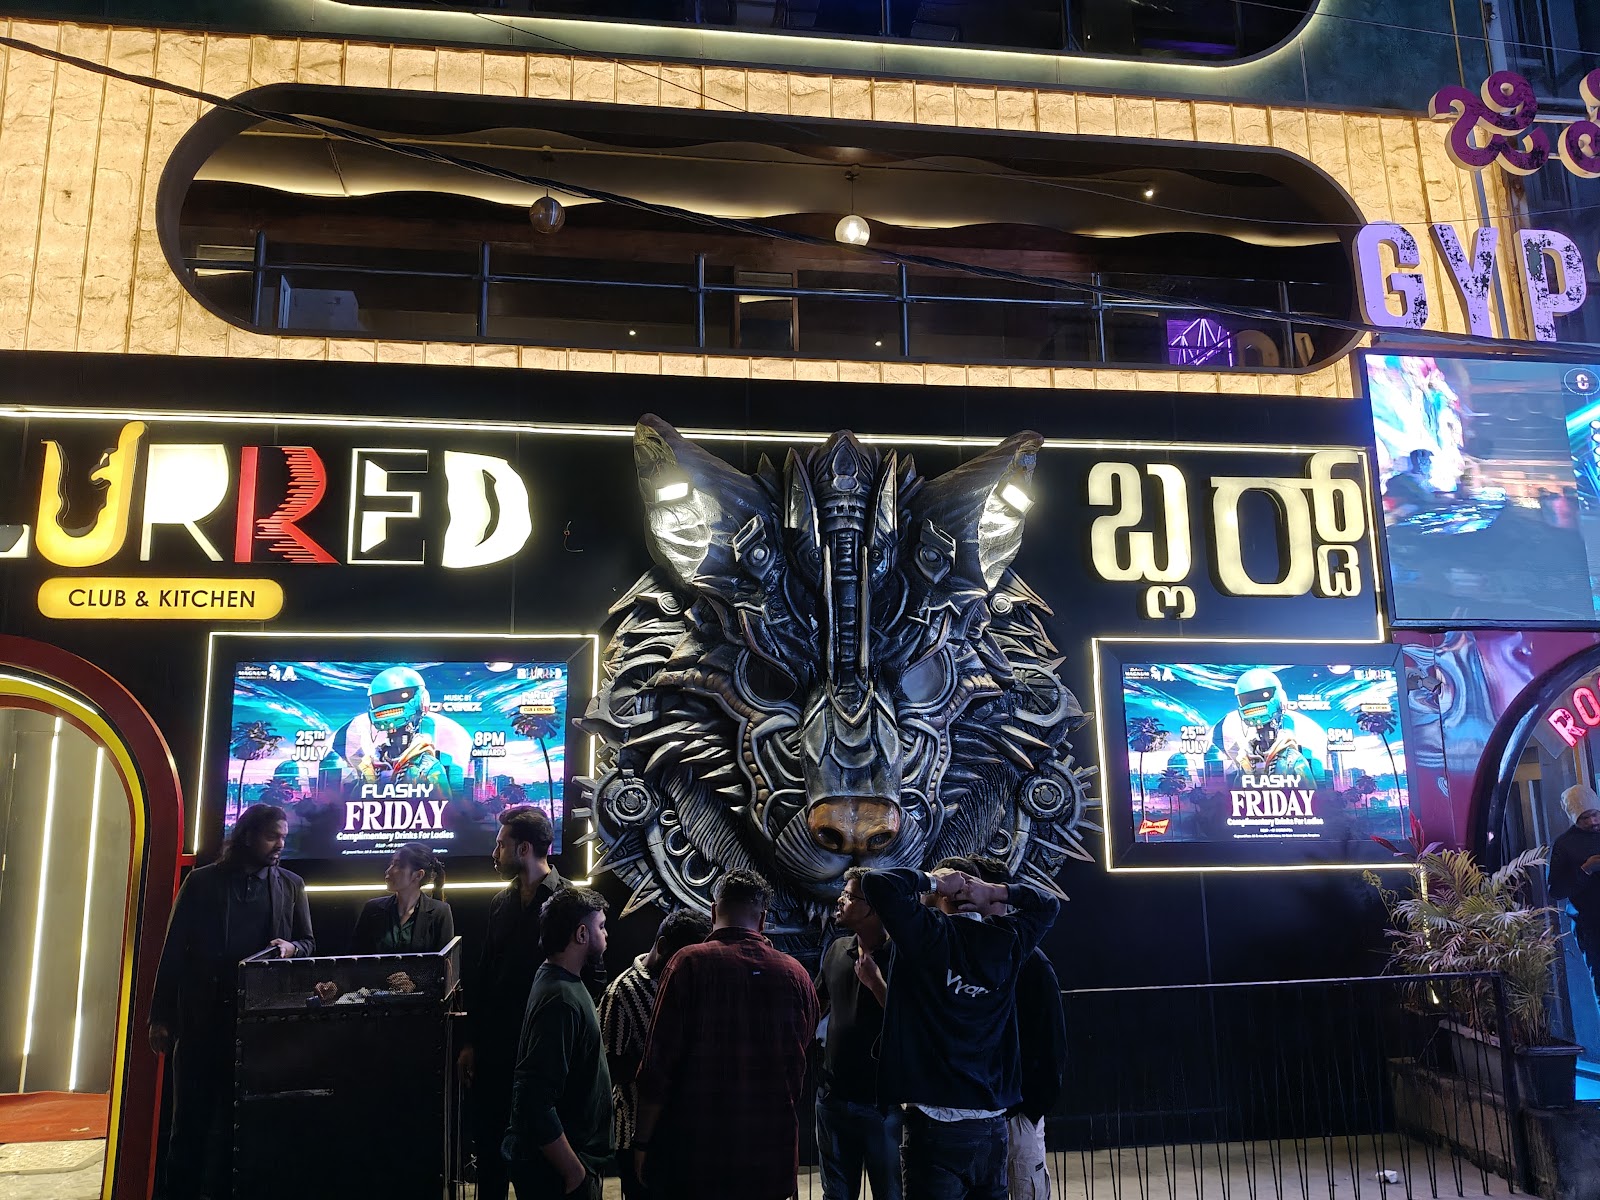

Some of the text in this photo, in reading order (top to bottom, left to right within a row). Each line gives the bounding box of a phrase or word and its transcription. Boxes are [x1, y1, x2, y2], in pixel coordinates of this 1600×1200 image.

[1355, 220, 1600, 343] GYP
[68, 588, 256, 608] CLUB & KITCHEN
[1547, 674, 1600, 748] RO
[474, 731, 505, 747] 8PM
[1327, 728, 1354, 742] 8PM
[291, 745, 328, 761] JULY
[472, 748, 506, 757] ONWARDS
[1179, 740, 1209, 754] JULY
[1241, 774, 1301, 788] FLASHY
[361, 783, 434, 799] FLASHY
[1230, 790, 1315, 817] FRIDAY
[343, 800, 449, 831] FRIDAY
[336, 830, 455, 842] Complimentary Drinks For Ladies
